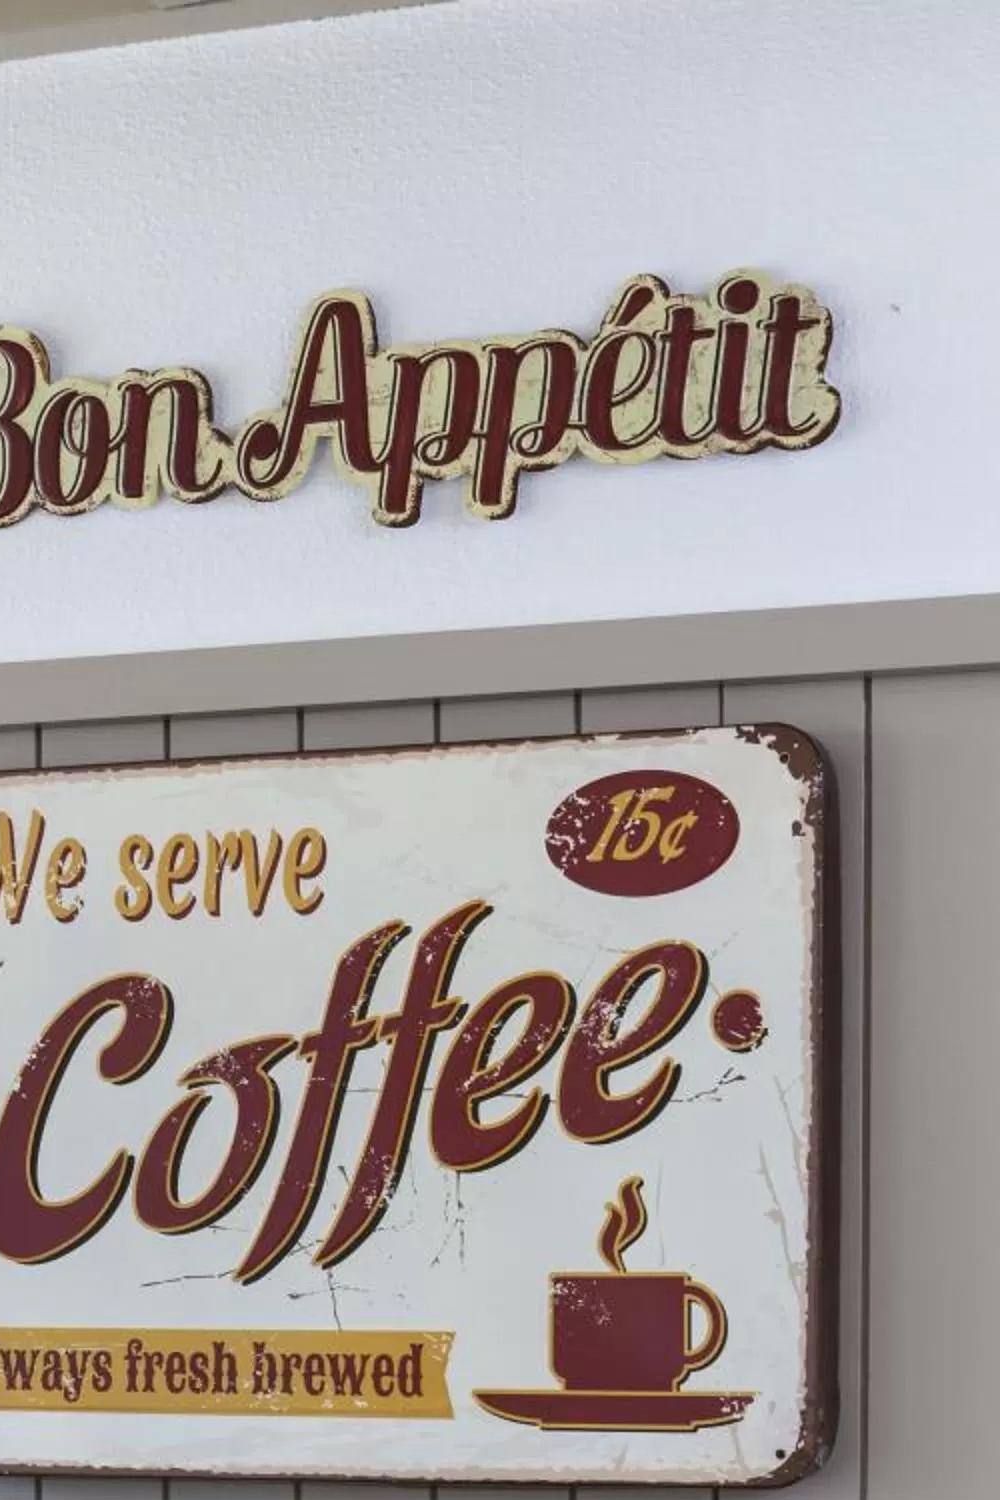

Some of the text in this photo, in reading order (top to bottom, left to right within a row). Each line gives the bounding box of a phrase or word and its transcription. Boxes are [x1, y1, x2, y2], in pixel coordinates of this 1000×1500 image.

[234, 279, 822, 516] Appétit
[585, 783, 699, 866] 15¢
[113, 825, 328, 923] serve
[124, 1337, 239, 1396] fresh
[251, 1341, 424, 1398] brewed
